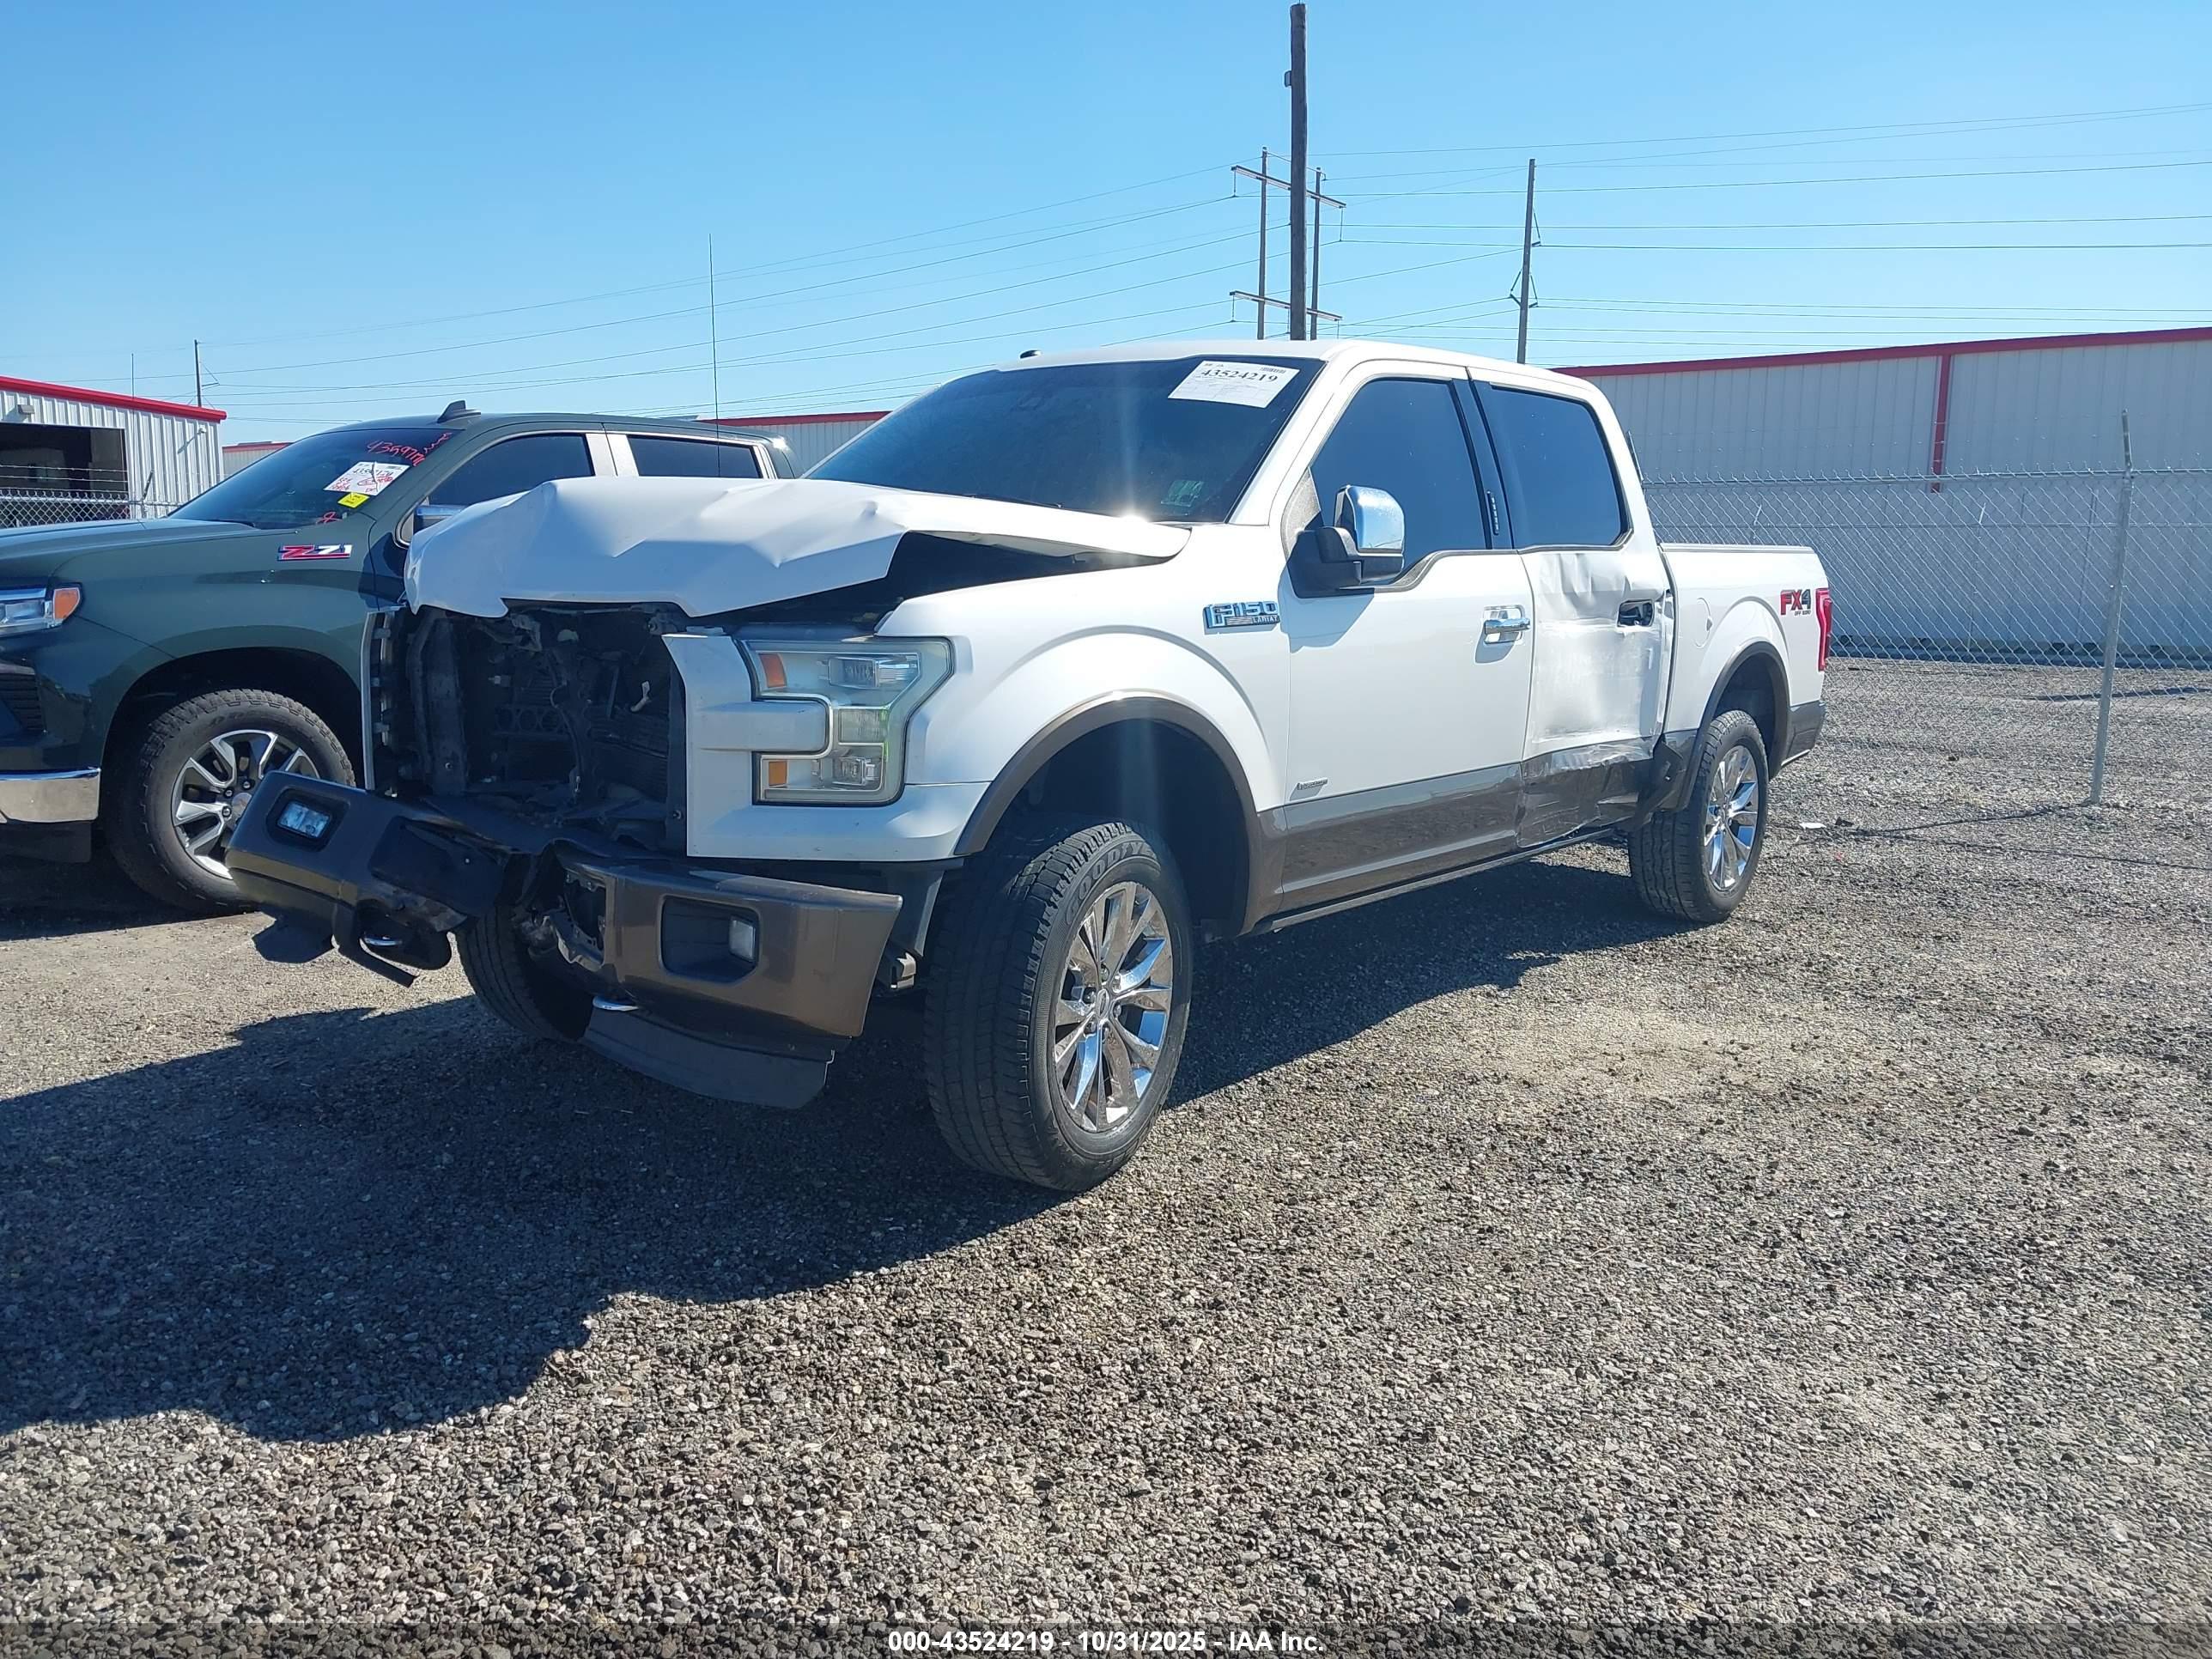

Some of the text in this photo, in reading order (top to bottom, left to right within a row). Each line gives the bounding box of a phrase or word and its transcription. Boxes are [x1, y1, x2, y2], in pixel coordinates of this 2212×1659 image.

[1200, 368, 1279, 383] 43524219
[278, 544, 353, 561] Z71
[1780, 589, 1811, 616] FX4
